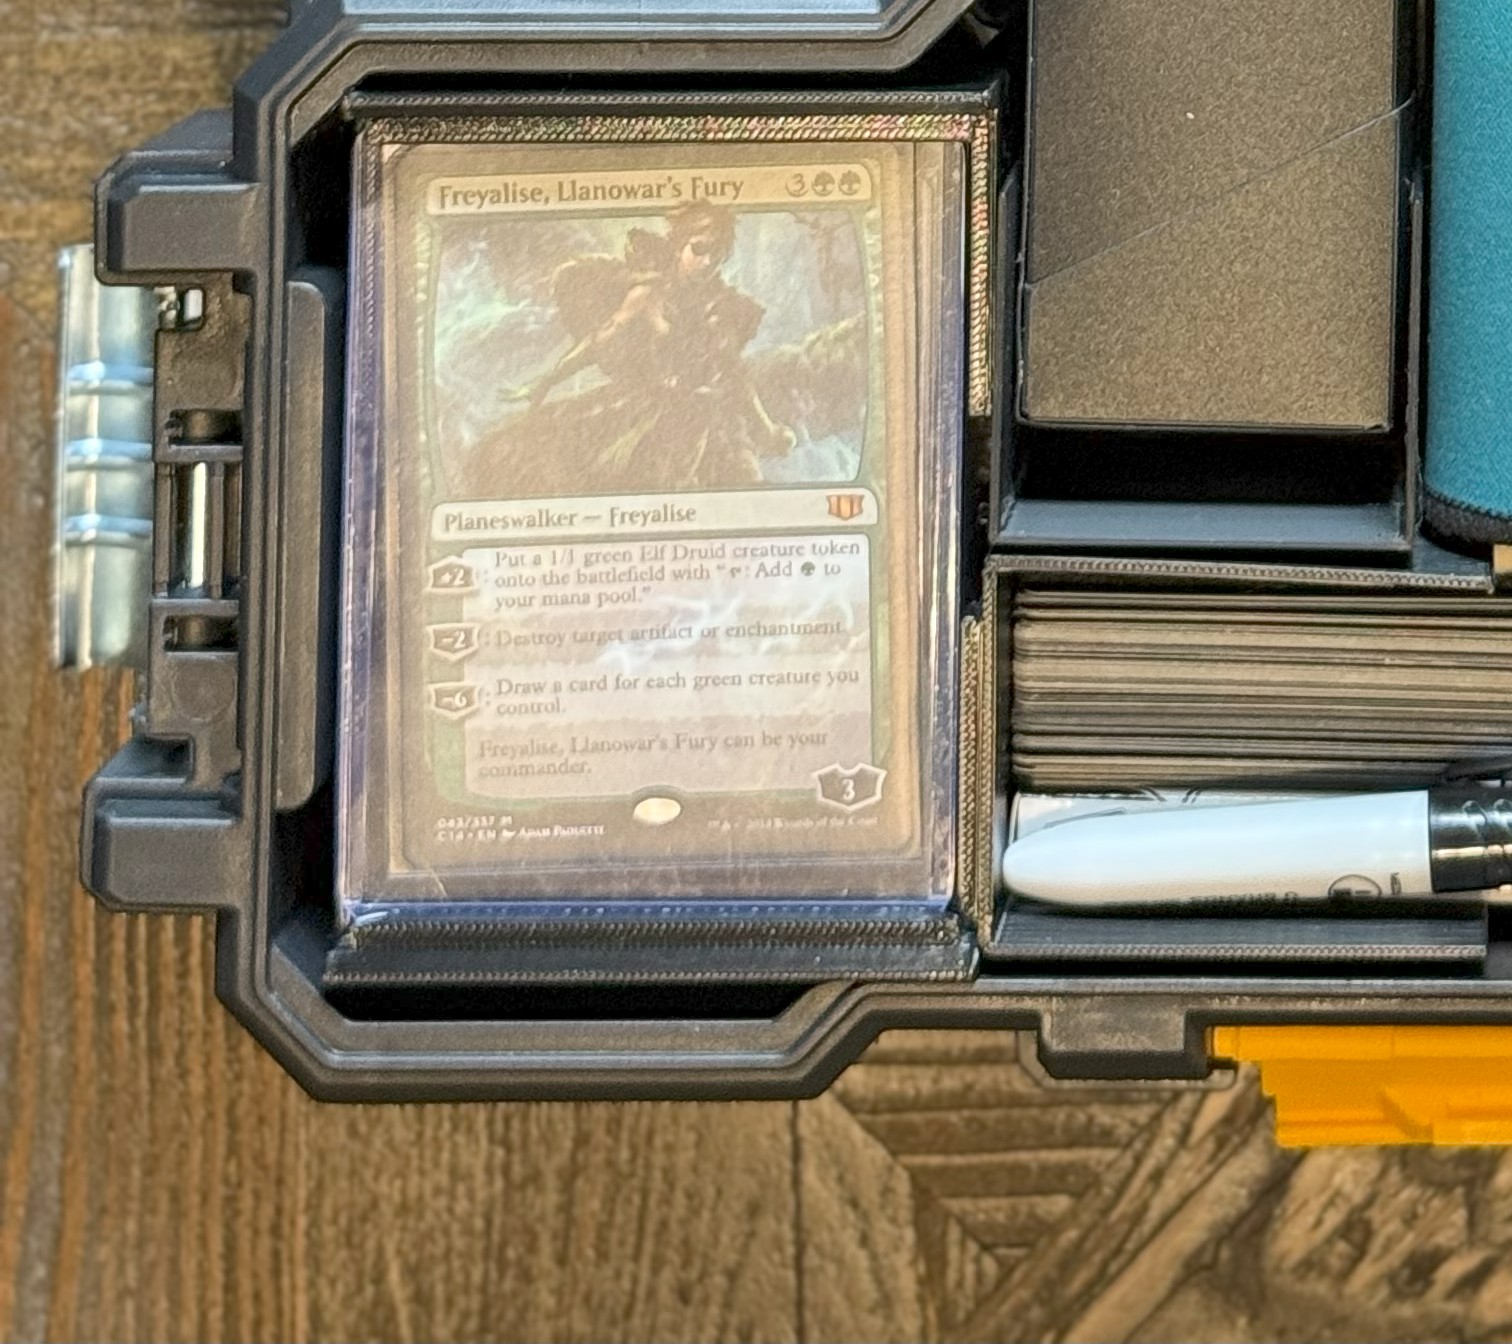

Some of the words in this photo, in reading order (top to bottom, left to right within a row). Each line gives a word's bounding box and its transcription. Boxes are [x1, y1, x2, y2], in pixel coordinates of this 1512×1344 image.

[439, 184, 549, 208] Freyalise,
[558, 177, 682, 202] Llanowar's
[691, 177, 744, 198] Fury
[444, 509, 578, 532] Planeswalker
[610, 505, 696, 528] Freyalise
[494, 552, 525, 567] Put
[532, 554, 542, 566] a
[584, 551, 632, 567] green
[641, 544, 667, 561] Elf
[673, 543, 725, 560] Druid
[733, 543, 804, 558] creature
[812, 541, 860, 556] token
[497, 630, 566, 647] Destroy
[572, 628, 623, 644] target
[631, 625, 693, 643] artifact
[701, 626, 720, 639] or
[498, 679, 546, 696] Draw
[554, 681, 562, 694] a
[570, 677, 608, 692] card
[614, 674, 639, 691] for
[646, 672, 686, 689] each
[693, 672, 742, 689] green
[749, 670, 821, 686] creature
[827, 670, 859, 686] you
[841, 780, 855, 800] 3
